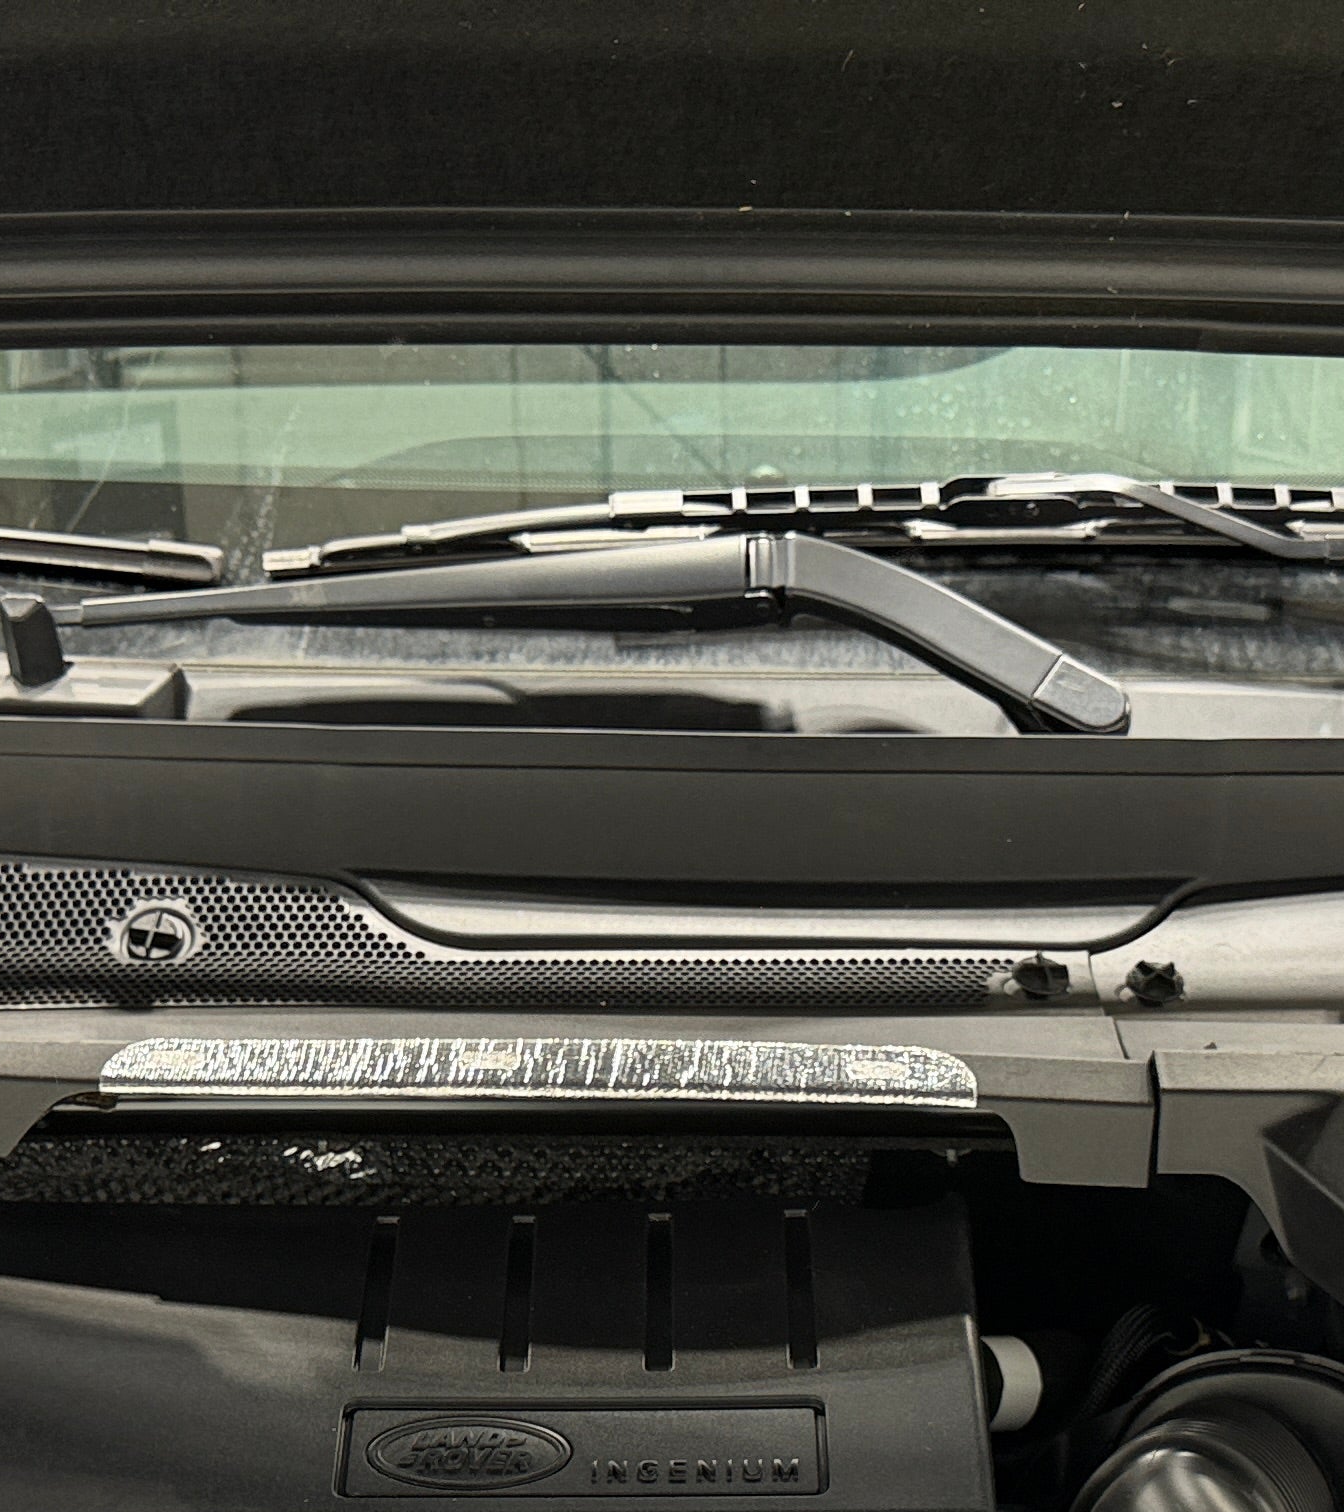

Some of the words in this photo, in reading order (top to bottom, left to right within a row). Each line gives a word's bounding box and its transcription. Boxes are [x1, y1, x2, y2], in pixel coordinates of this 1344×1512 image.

[411, 1430, 506, 1451] LAND
[415, 1448, 533, 1475] ROVER
[590, 1457, 800, 1485] INGENIUM
